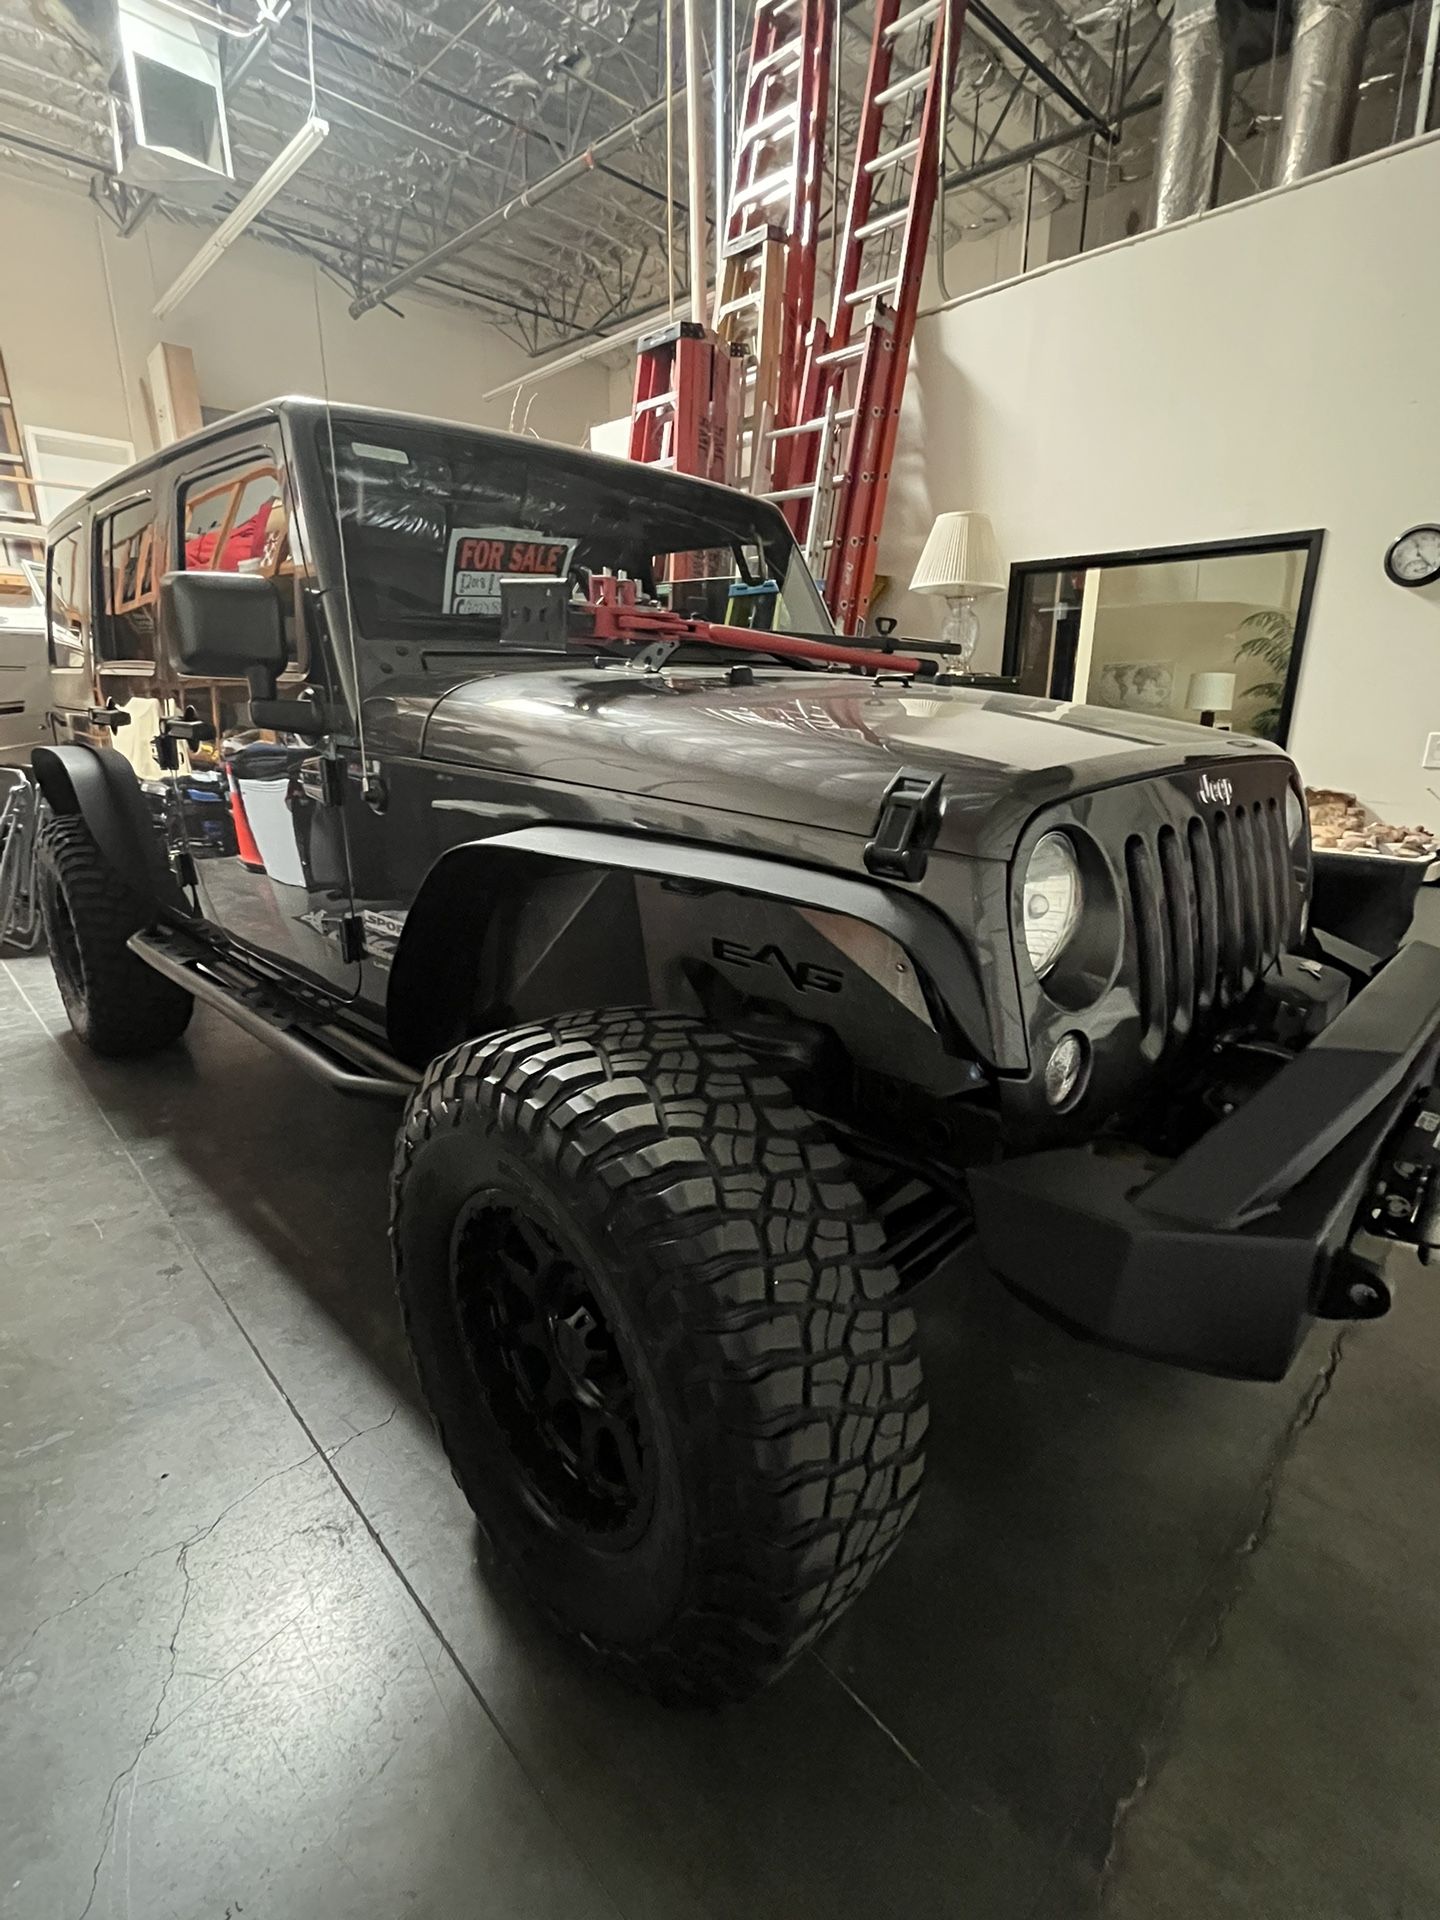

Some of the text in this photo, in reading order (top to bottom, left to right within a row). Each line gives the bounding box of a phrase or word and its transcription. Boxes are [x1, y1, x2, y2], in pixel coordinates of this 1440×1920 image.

[460, 538, 565, 573] FOR SALE
[1198, 773, 1233, 806] Jeep
